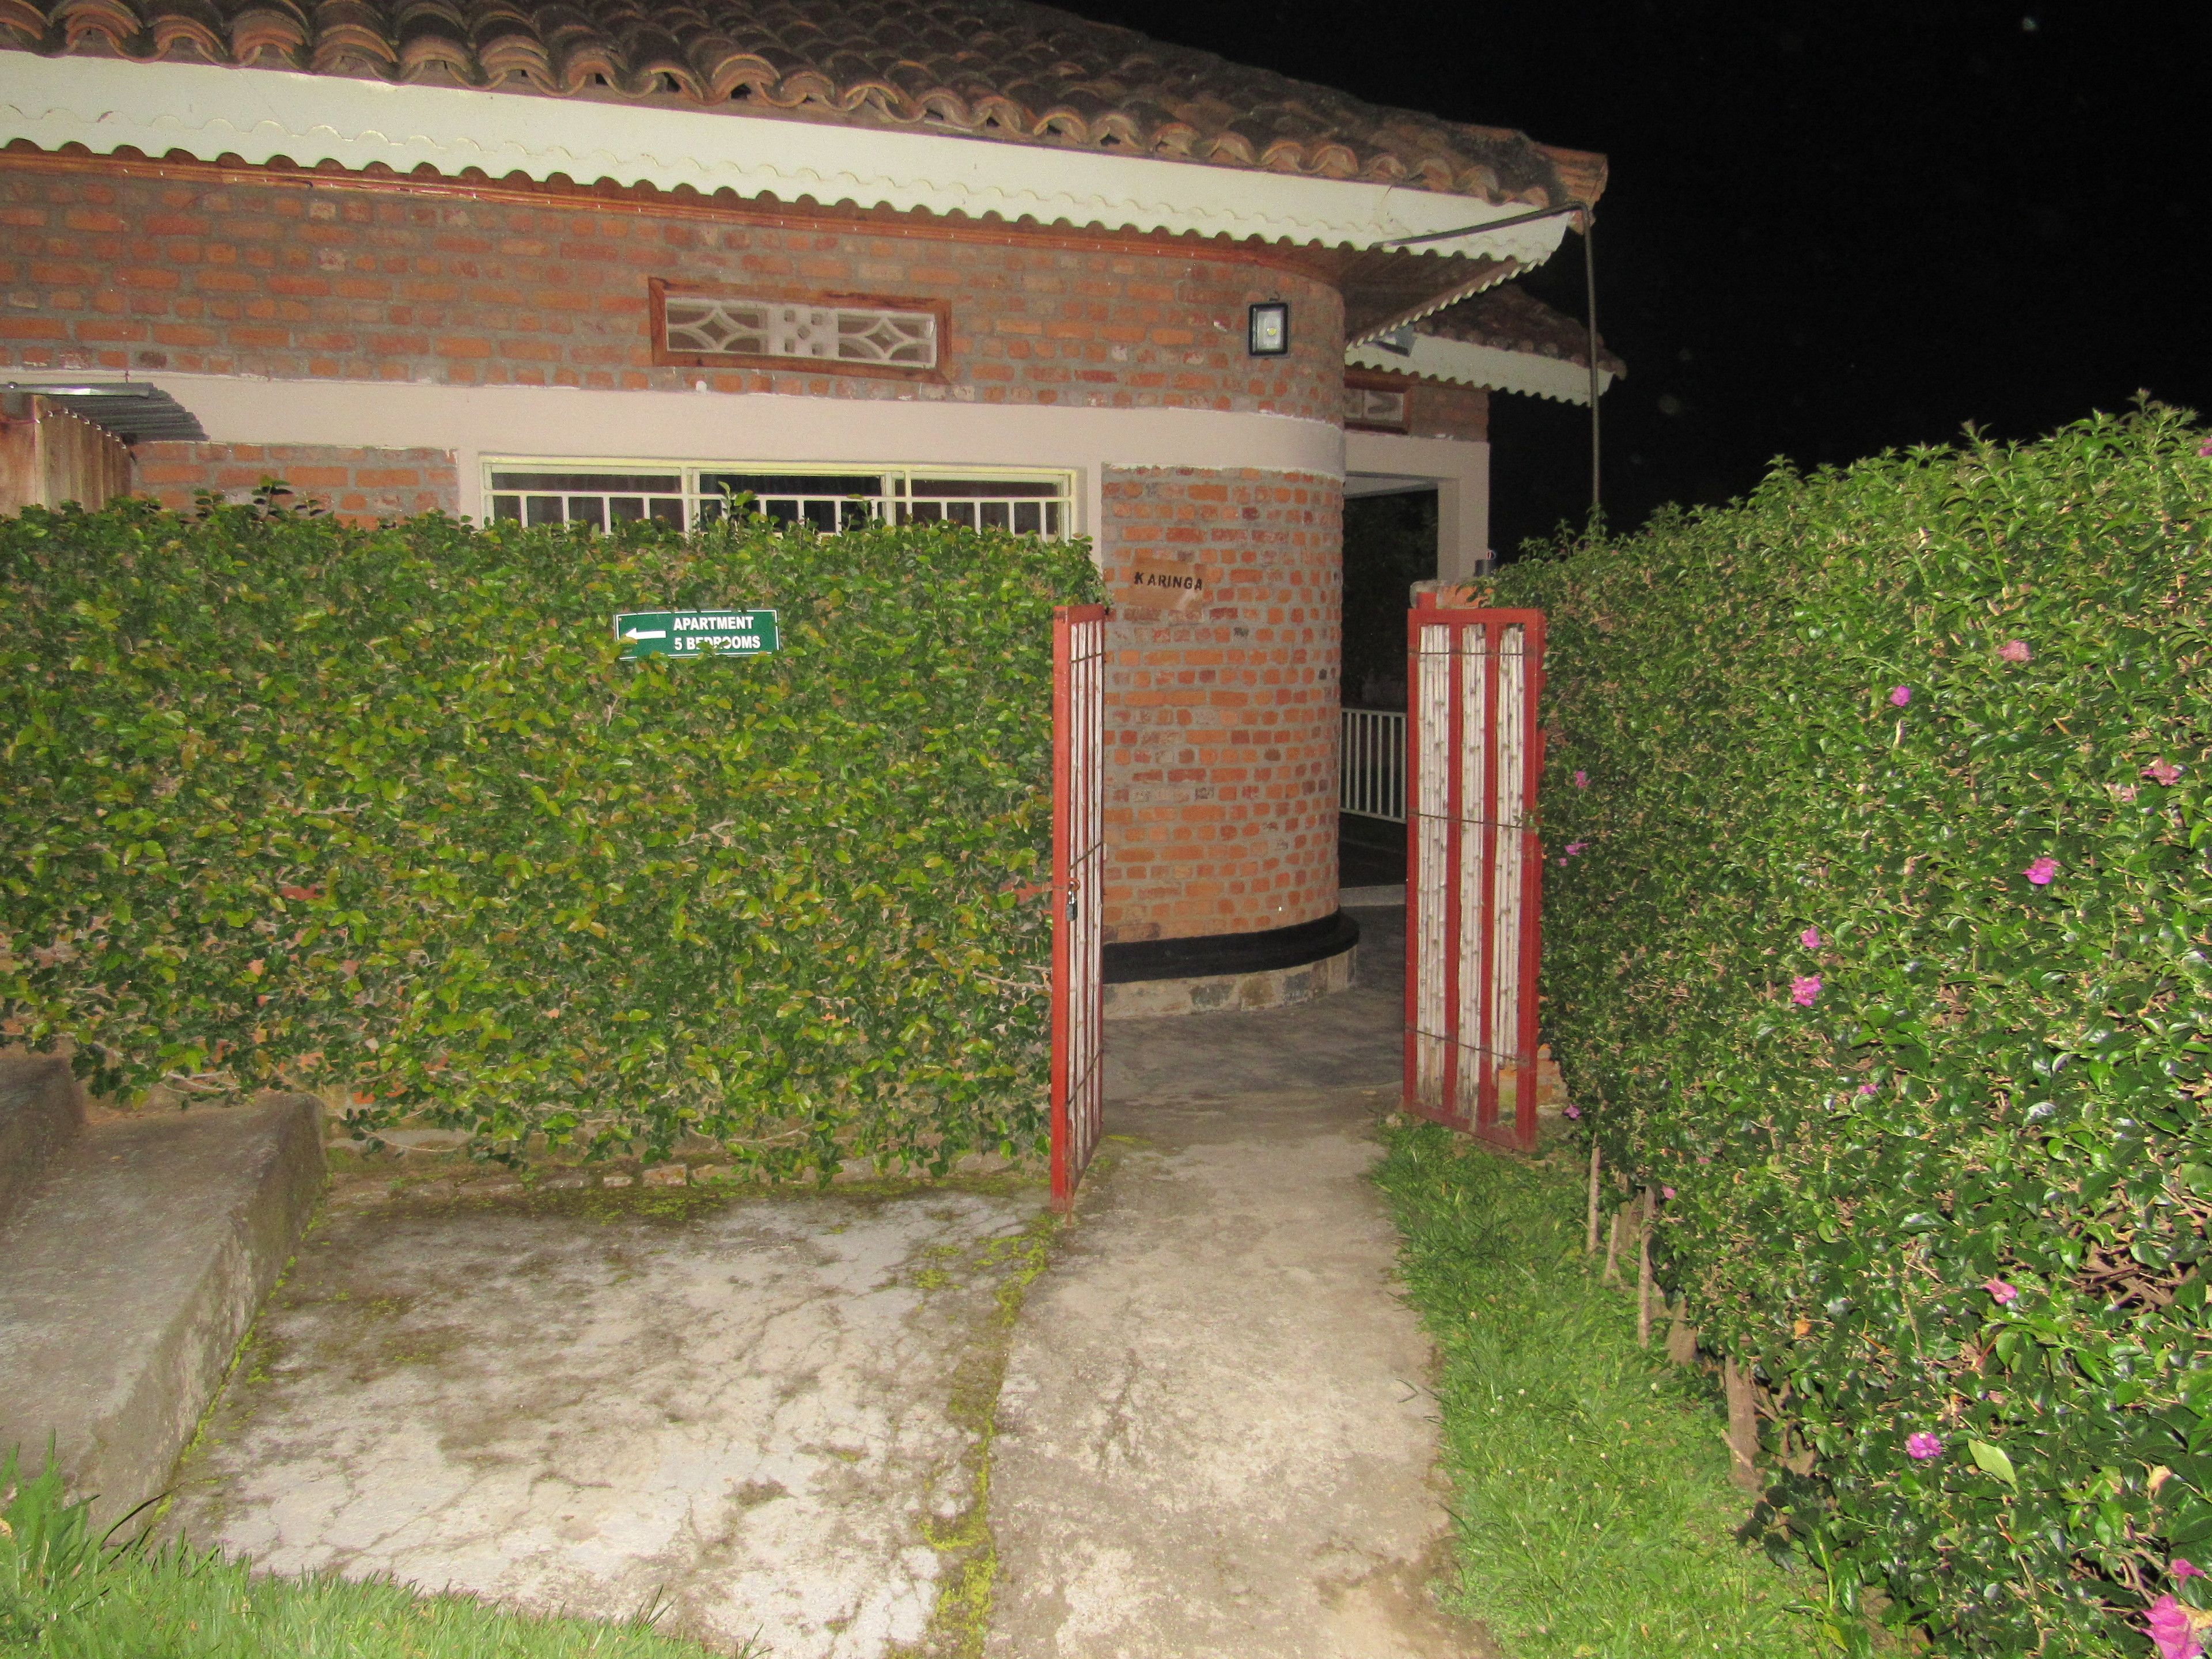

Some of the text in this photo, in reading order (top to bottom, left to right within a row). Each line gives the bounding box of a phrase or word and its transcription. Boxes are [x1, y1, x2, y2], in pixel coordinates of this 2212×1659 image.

[1134, 571, 1202, 590] KARINGA
[673, 616, 754, 631] APARTMENT
[675, 637, 683, 650] 5
